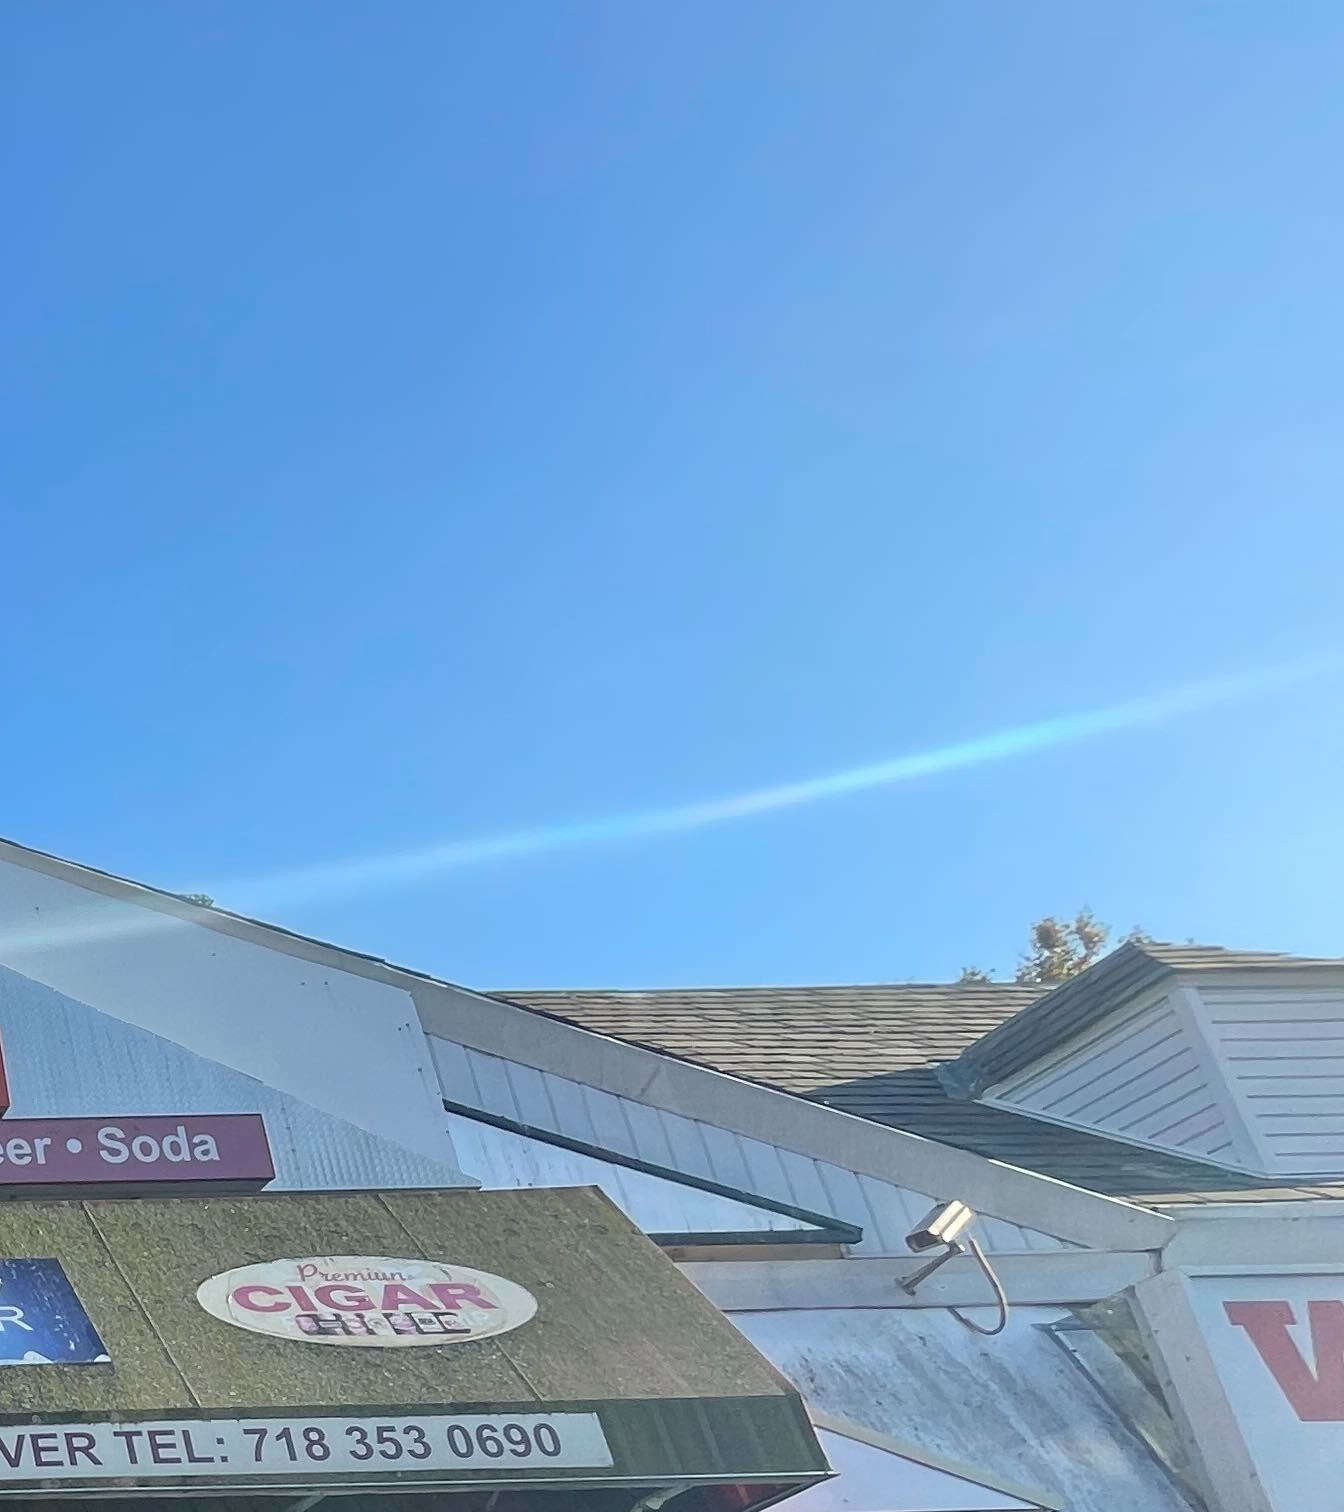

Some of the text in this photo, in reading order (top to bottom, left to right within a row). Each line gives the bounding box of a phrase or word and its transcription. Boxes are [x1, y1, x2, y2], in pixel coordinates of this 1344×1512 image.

[98, 1124, 220, 1162] Soda
[231, 1282, 498, 1313] CIGAR
[113, 1428, 230, 1464] TEL:
[243, 1426, 330, 1463] 718
[348, 1425, 432, 1461] 353
[448, 1422, 562, 1459] 0690
